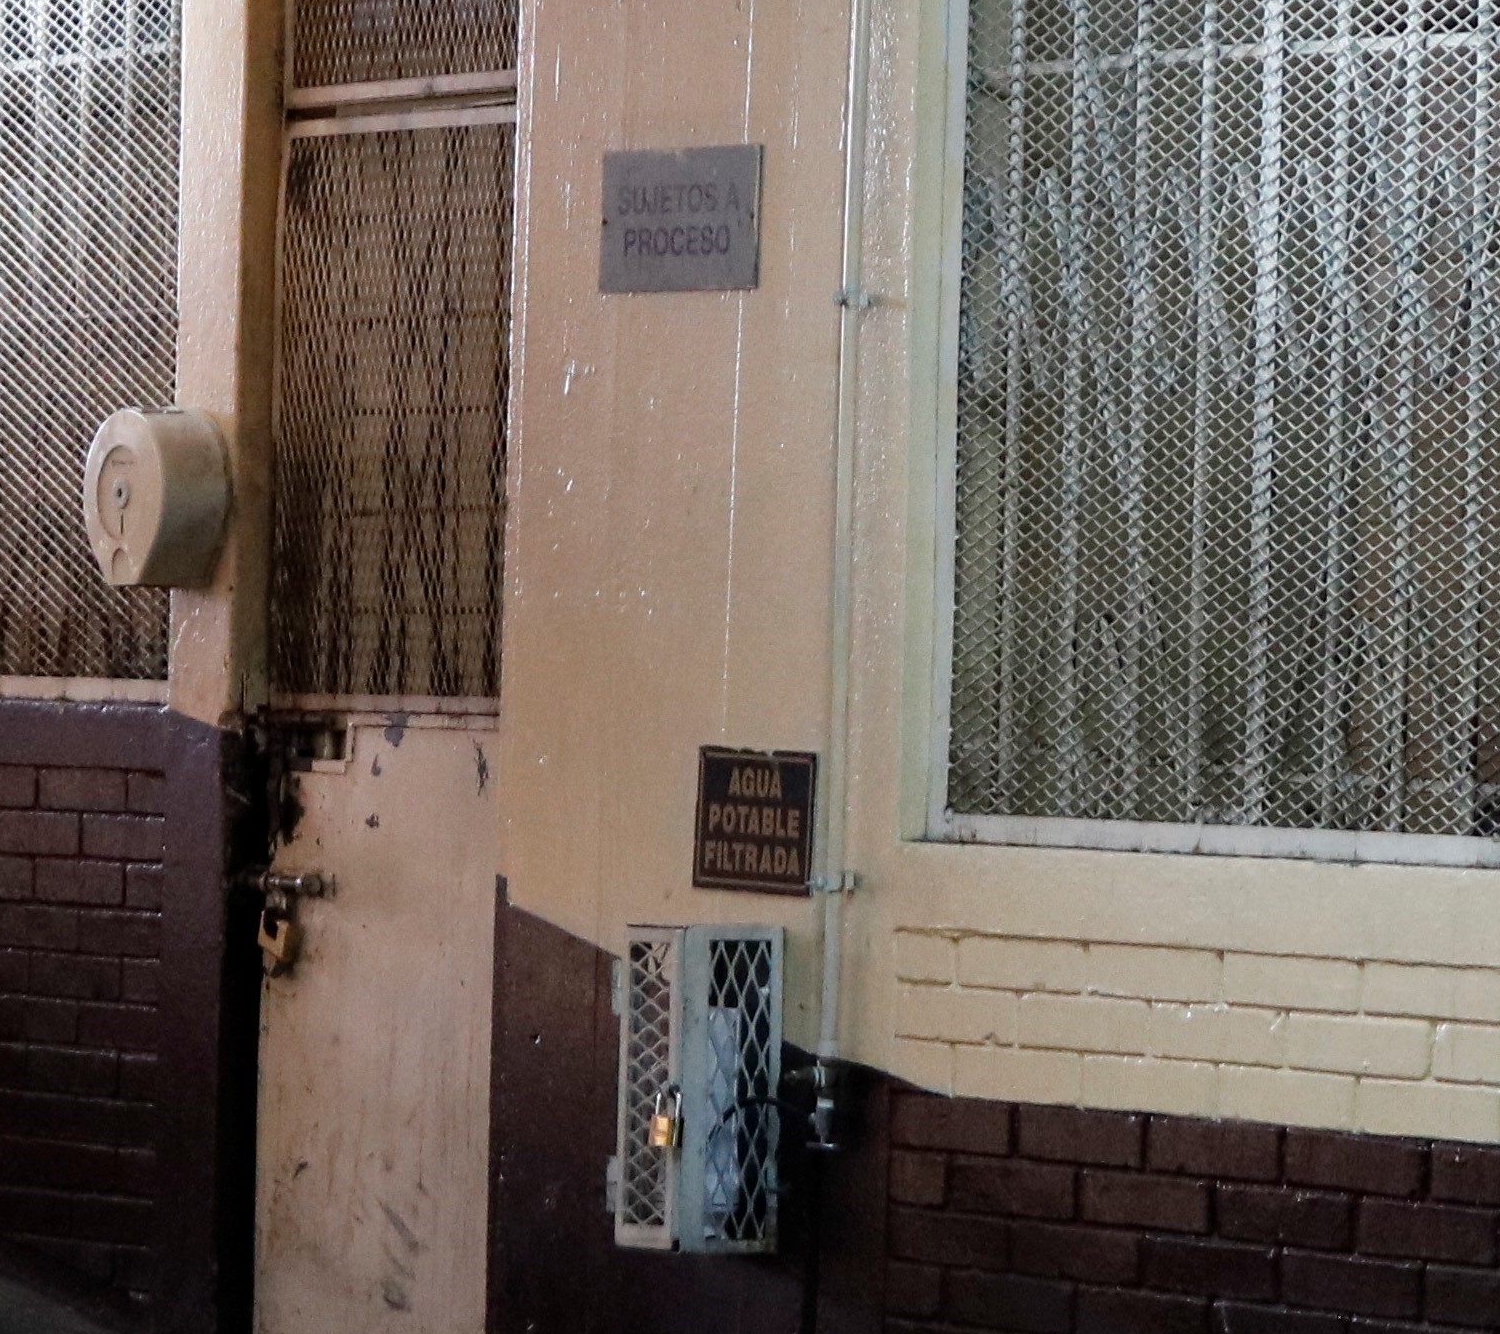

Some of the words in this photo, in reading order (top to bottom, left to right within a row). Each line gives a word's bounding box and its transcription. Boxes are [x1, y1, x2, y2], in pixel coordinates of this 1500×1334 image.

[618, 182, 719, 216] SUJETOS
[623, 225, 731, 257] PROCESO
[727, 767, 782, 800] AGUA
[708, 803, 801, 838] POTABLE
[703, 839, 800, 877] FILTRADA
